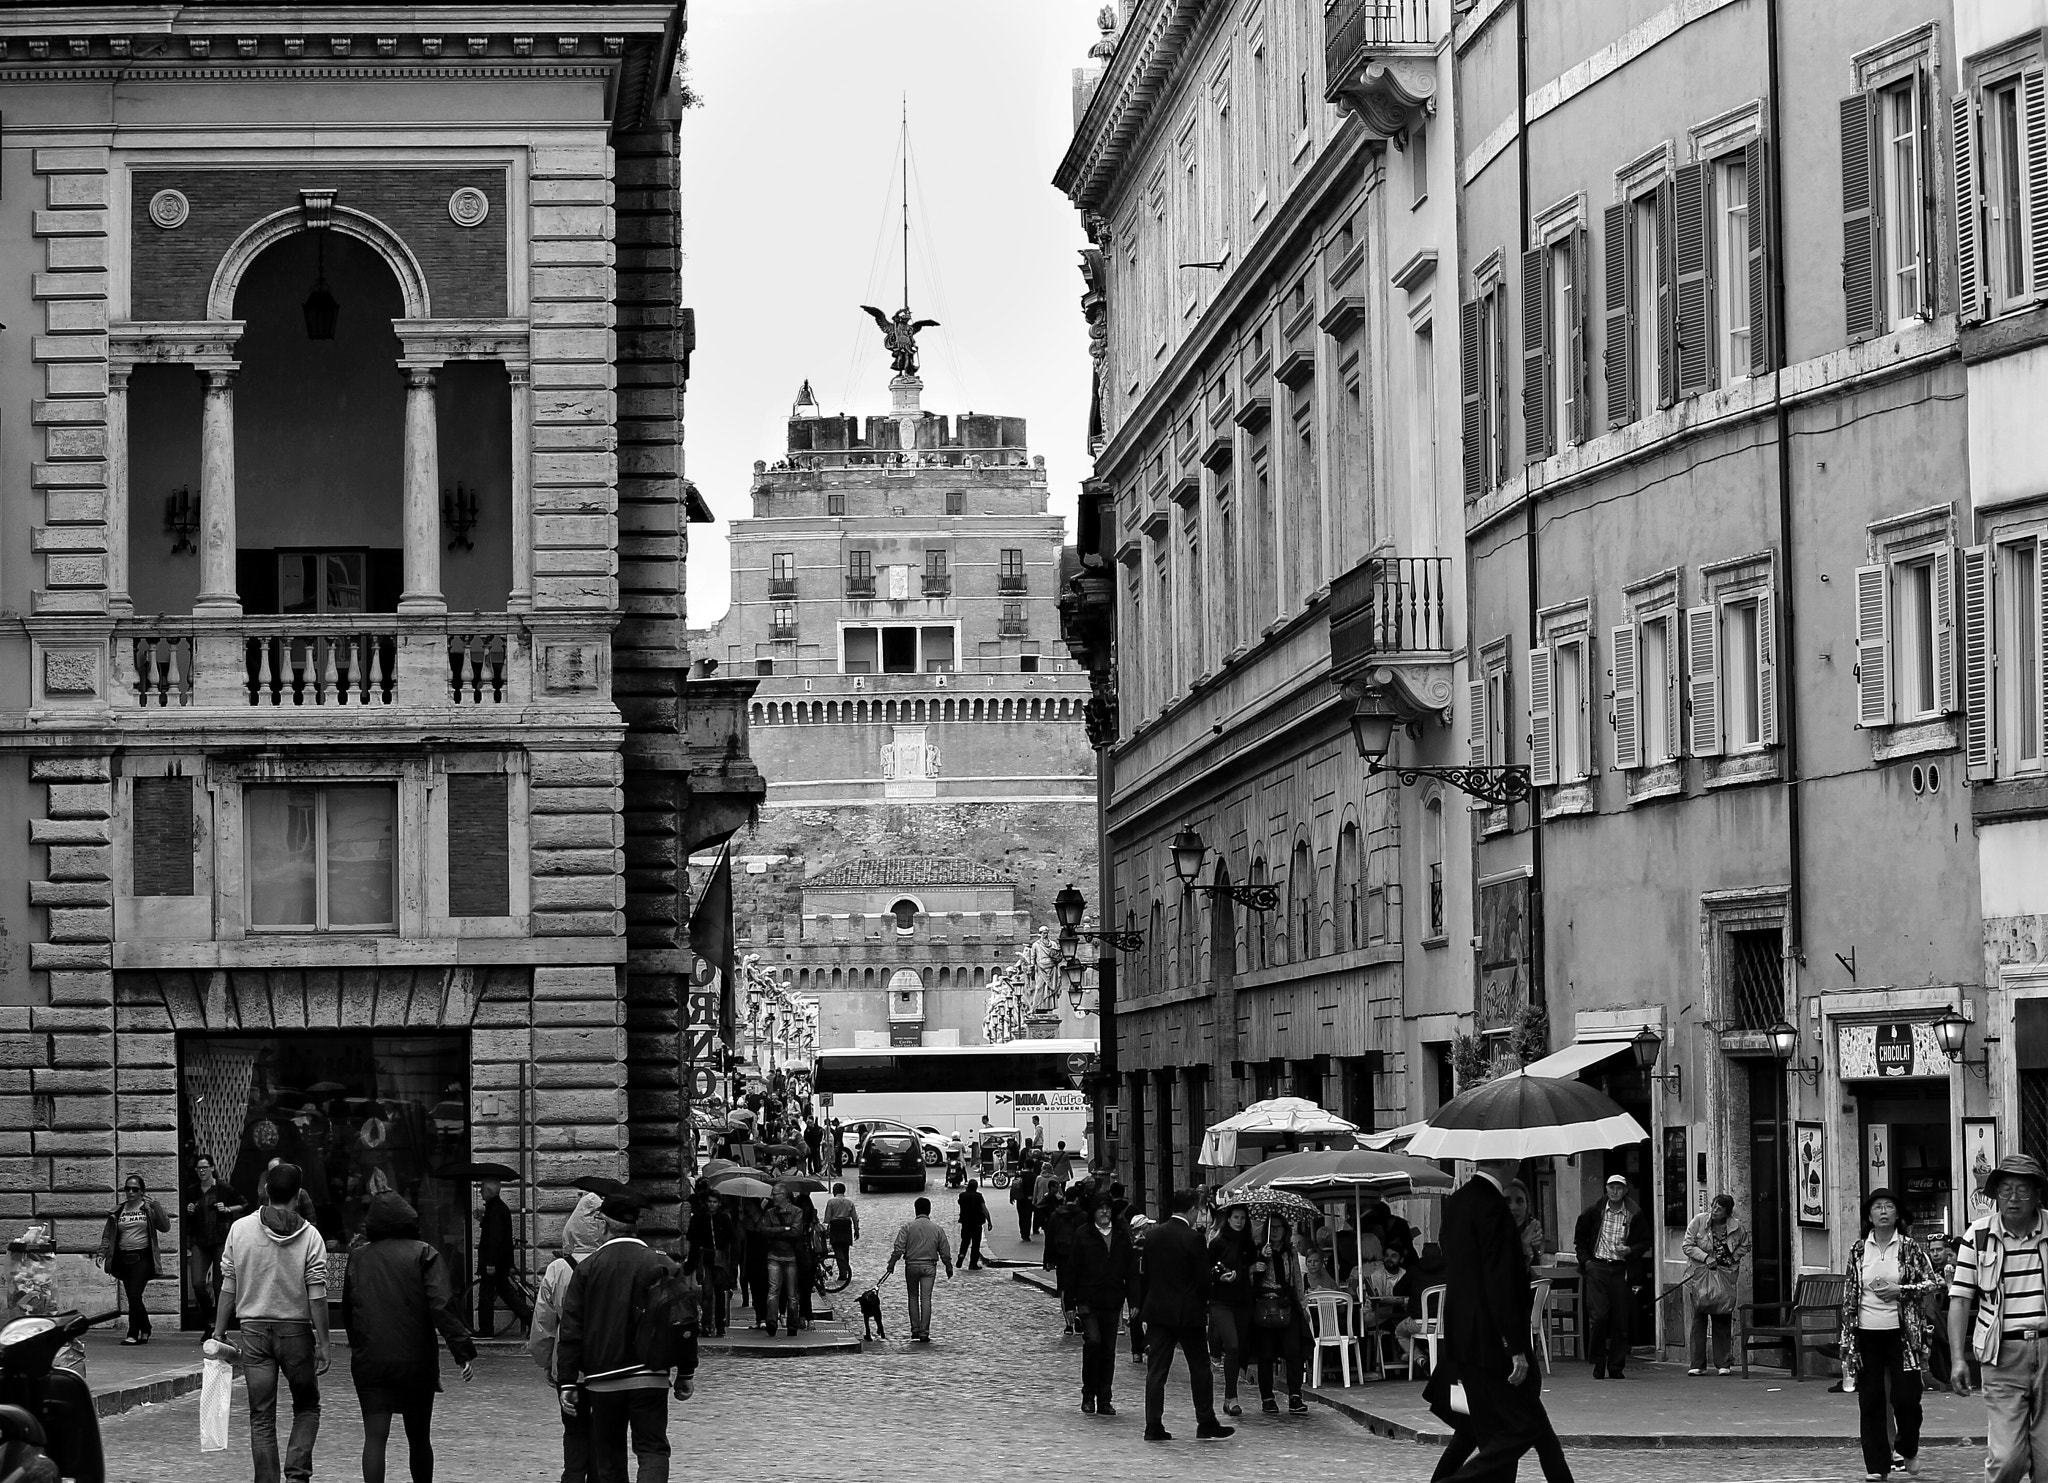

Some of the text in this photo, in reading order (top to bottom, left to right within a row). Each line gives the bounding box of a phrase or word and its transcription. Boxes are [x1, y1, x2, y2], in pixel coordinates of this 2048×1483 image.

[1880, 1044, 1910, 1062] CHOCOLAT
[1015, 1093, 1047, 1106] MMA
[1106, 1108, 1119, 1131] T
